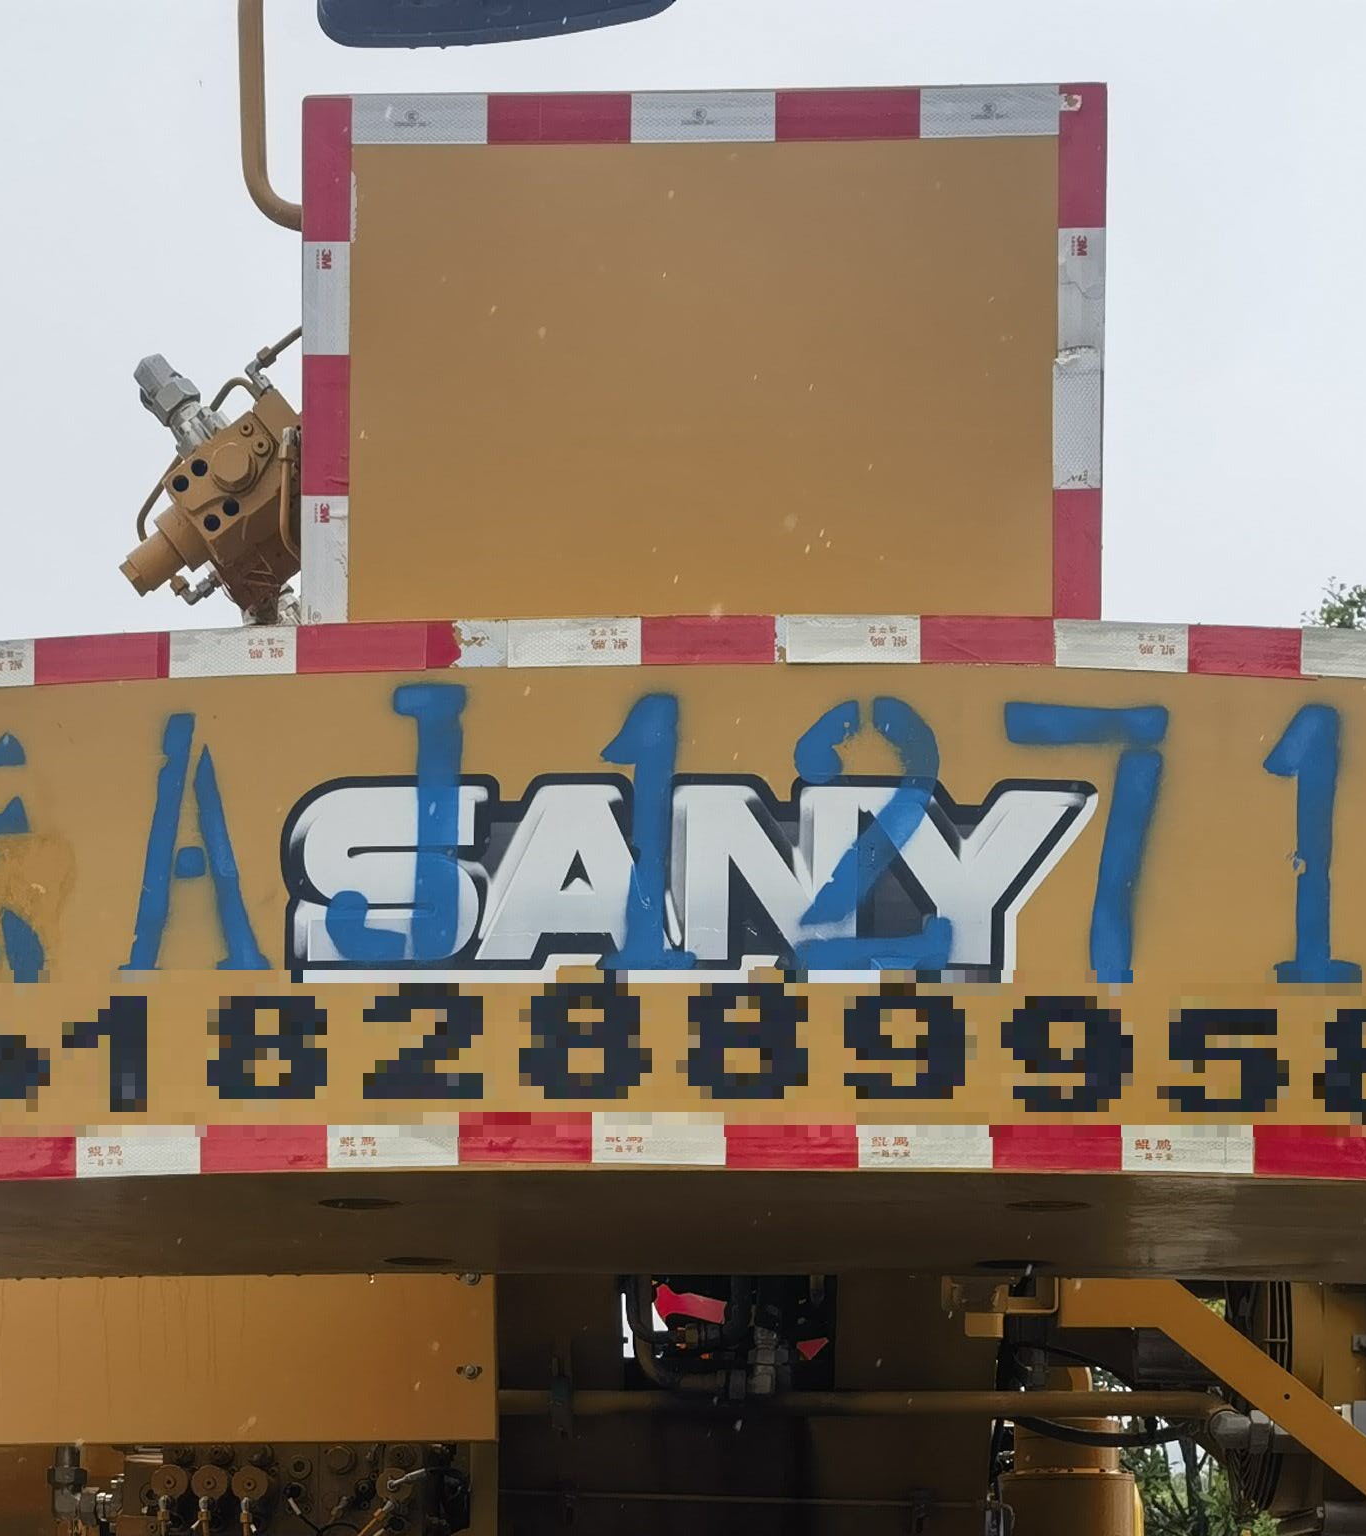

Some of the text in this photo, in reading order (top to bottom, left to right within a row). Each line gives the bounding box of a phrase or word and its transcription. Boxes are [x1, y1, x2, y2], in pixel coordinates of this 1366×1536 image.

[1077, 235, 1087, 256] 3M
[322, 249, 331, 269] 3M
[320, 503, 330, 523] 3M
[284, 774, 1098, 980] SANY
